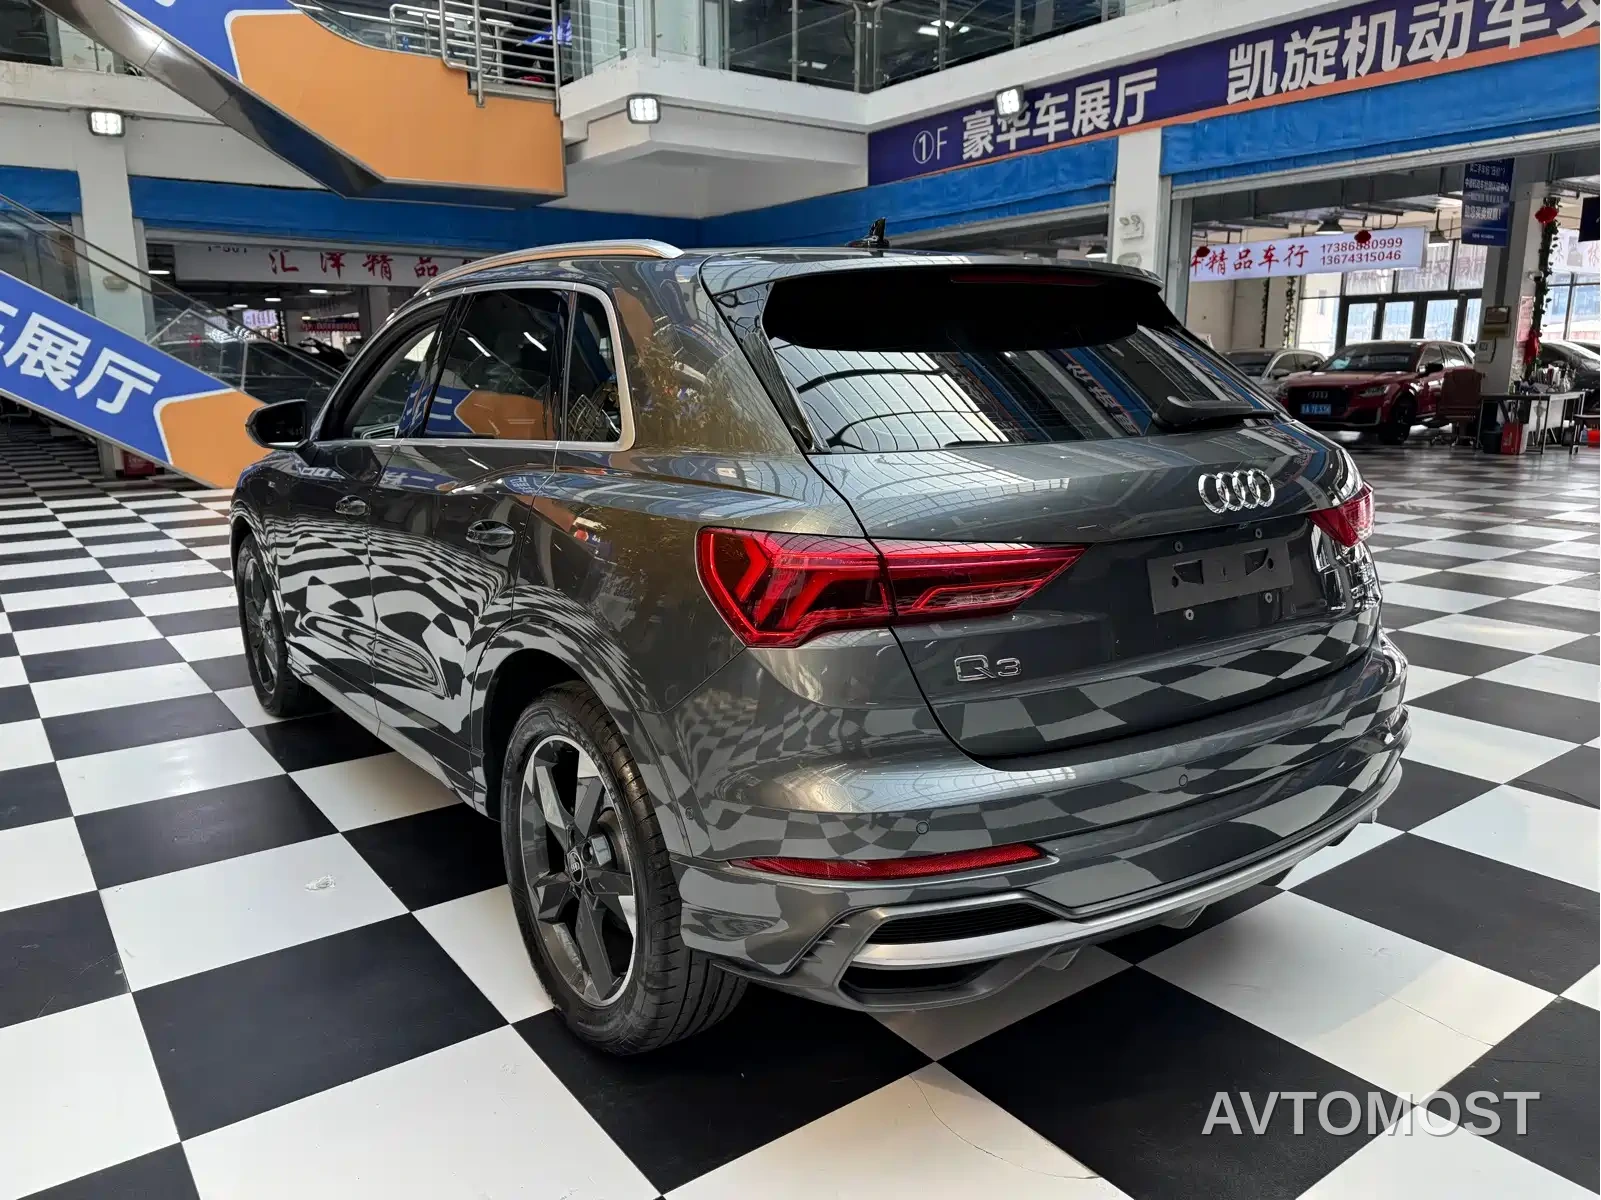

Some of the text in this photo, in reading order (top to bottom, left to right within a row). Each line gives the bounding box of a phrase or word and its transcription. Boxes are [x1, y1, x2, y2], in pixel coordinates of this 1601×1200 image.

[268, 249, 475, 281] 汇泽精品
[1320, 250, 1402, 266] 13674315046
[954, 654, 1021, 681] Q3
